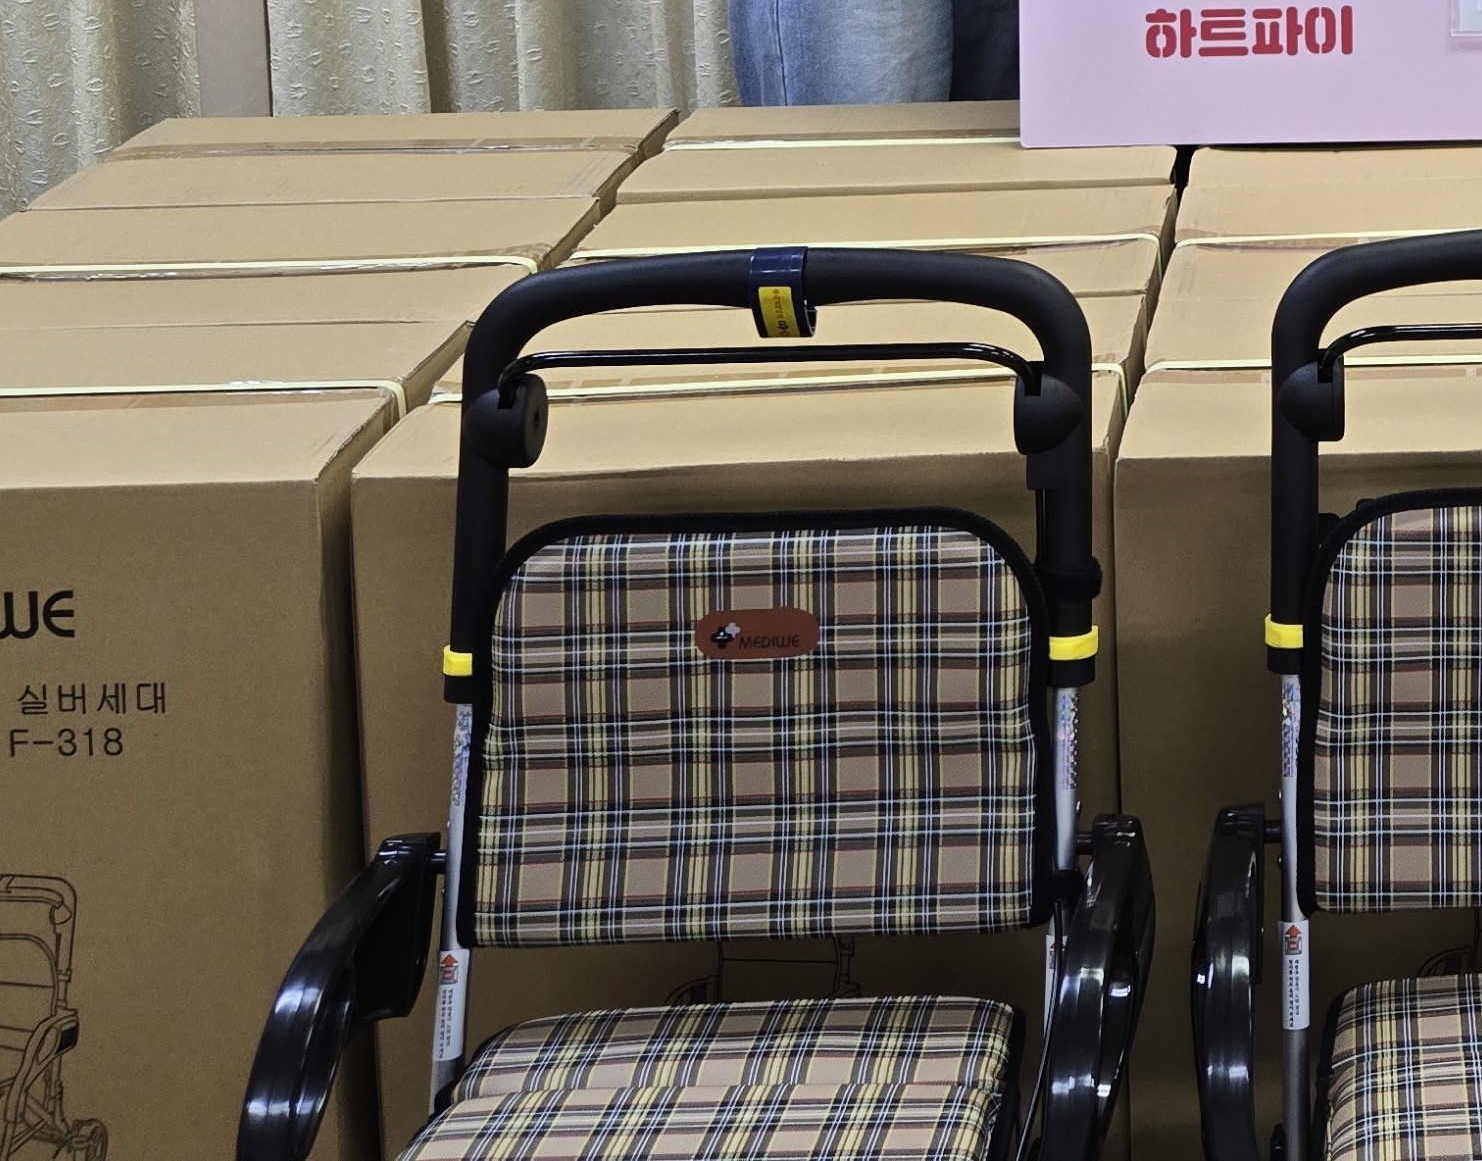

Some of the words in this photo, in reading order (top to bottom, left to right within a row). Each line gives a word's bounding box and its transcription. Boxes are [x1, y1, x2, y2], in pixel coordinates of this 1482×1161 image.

[1145, 5, 1353, 59] 하트파이
[18, 681, 166, 715] 실버세대
[9, 727, 124, 757] F-318
